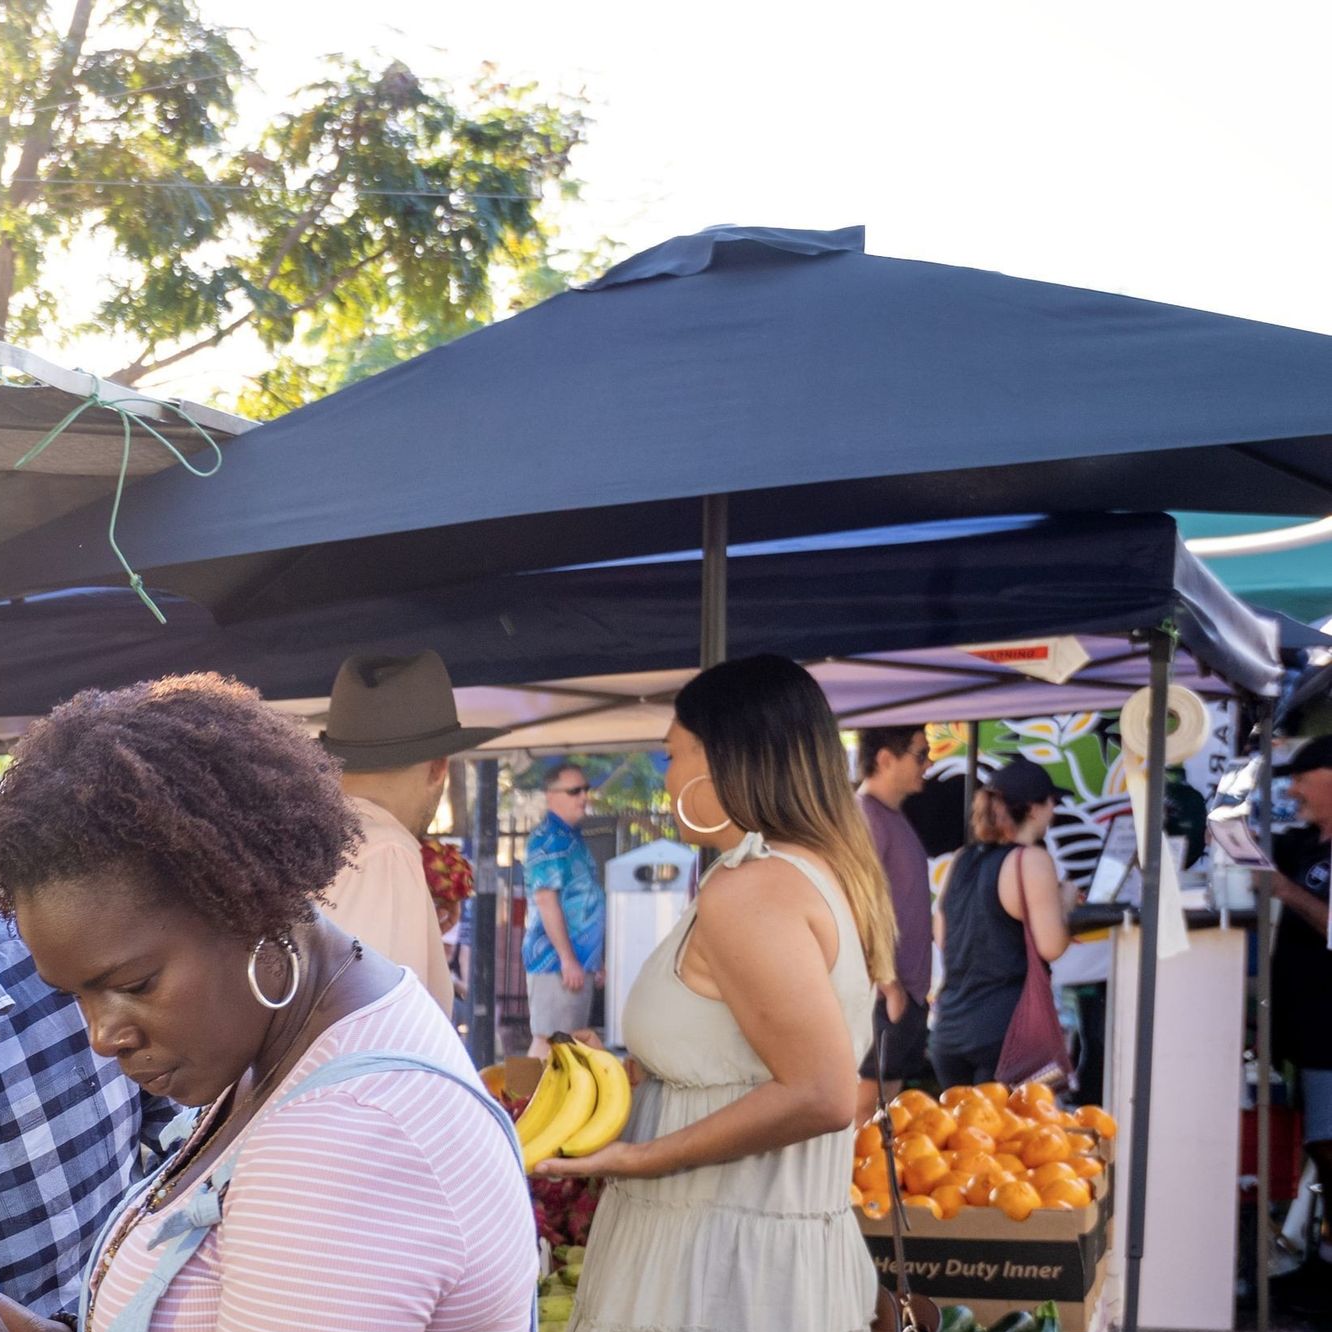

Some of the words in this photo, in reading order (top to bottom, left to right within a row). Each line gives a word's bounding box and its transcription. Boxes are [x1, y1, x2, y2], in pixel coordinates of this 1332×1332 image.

[874, 1257, 940, 1278] Heavy
[945, 1259, 998, 1280] Duty
[1002, 1260, 1063, 1280] Inner
